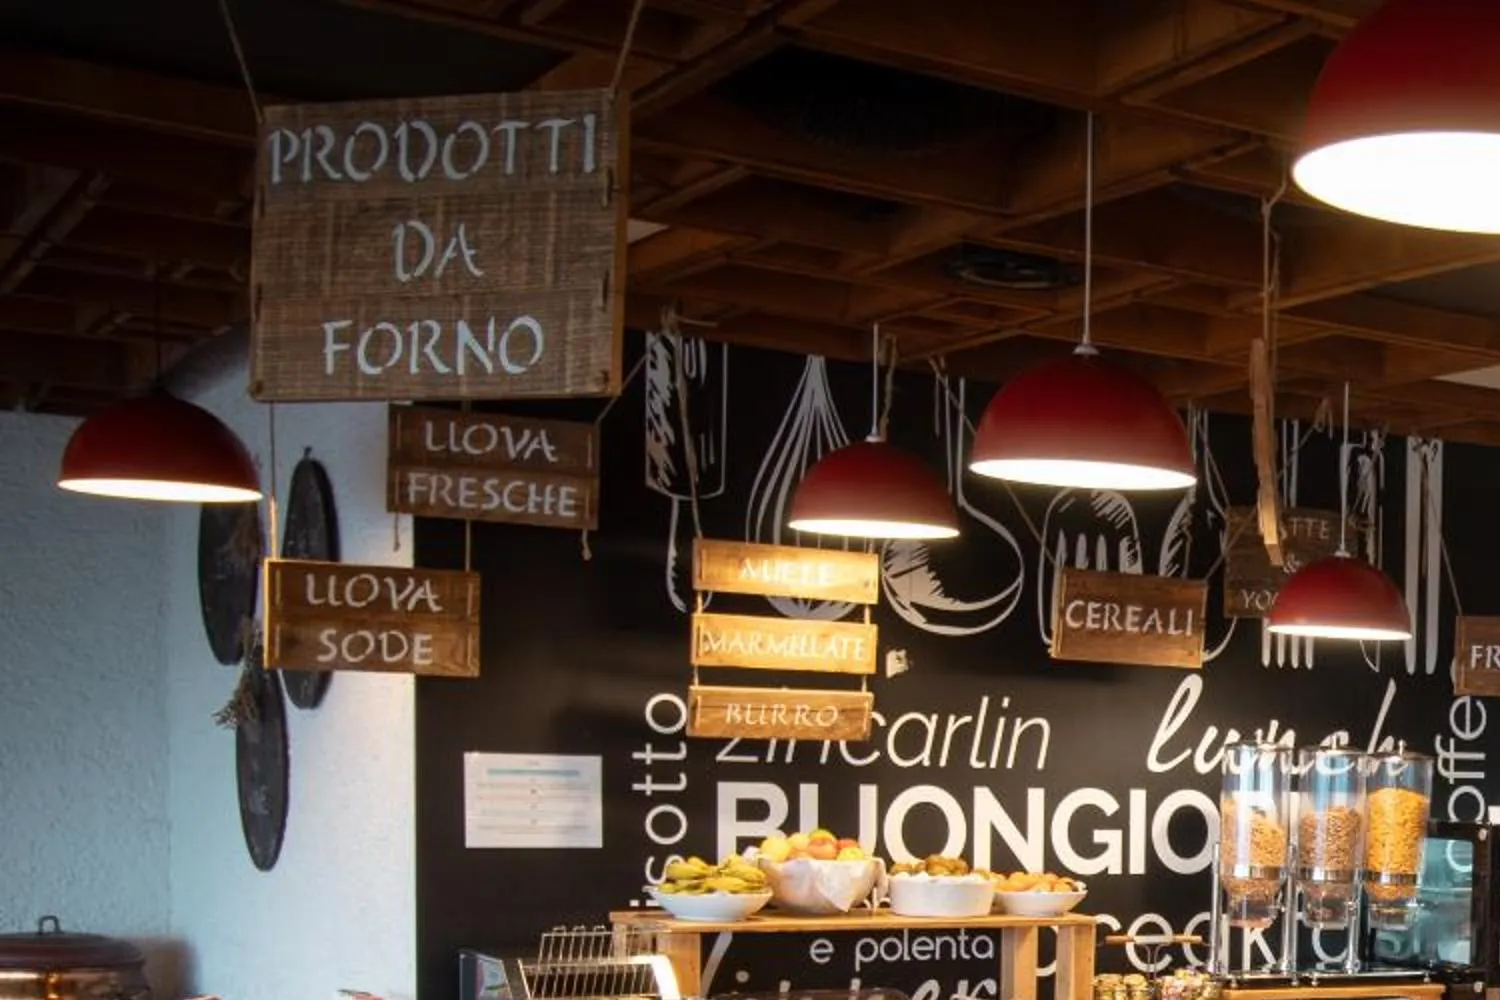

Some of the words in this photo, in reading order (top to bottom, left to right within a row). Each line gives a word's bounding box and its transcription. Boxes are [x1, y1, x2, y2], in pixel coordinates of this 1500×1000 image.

[268, 113, 597, 184] PRODOTTI
[393, 220, 485, 282] DA
[322, 315, 544, 376] FORNO
[425, 421, 559, 463] UOVA
[407, 470, 578, 518] FRESCHE
[305, 572, 443, 613] UOVA
[1064, 599, 1195, 637] CEREALI
[316, 628, 434, 665] SODE
[724, 703, 839, 728] BURRO
[1146, 673, 1411, 776] lunch
[630, 693, 688, 907] isotto
[716, 780, 1300, 876] BUONGIO
[809, 938, 835, 964] e
[854, 928, 994, 972] polenta
